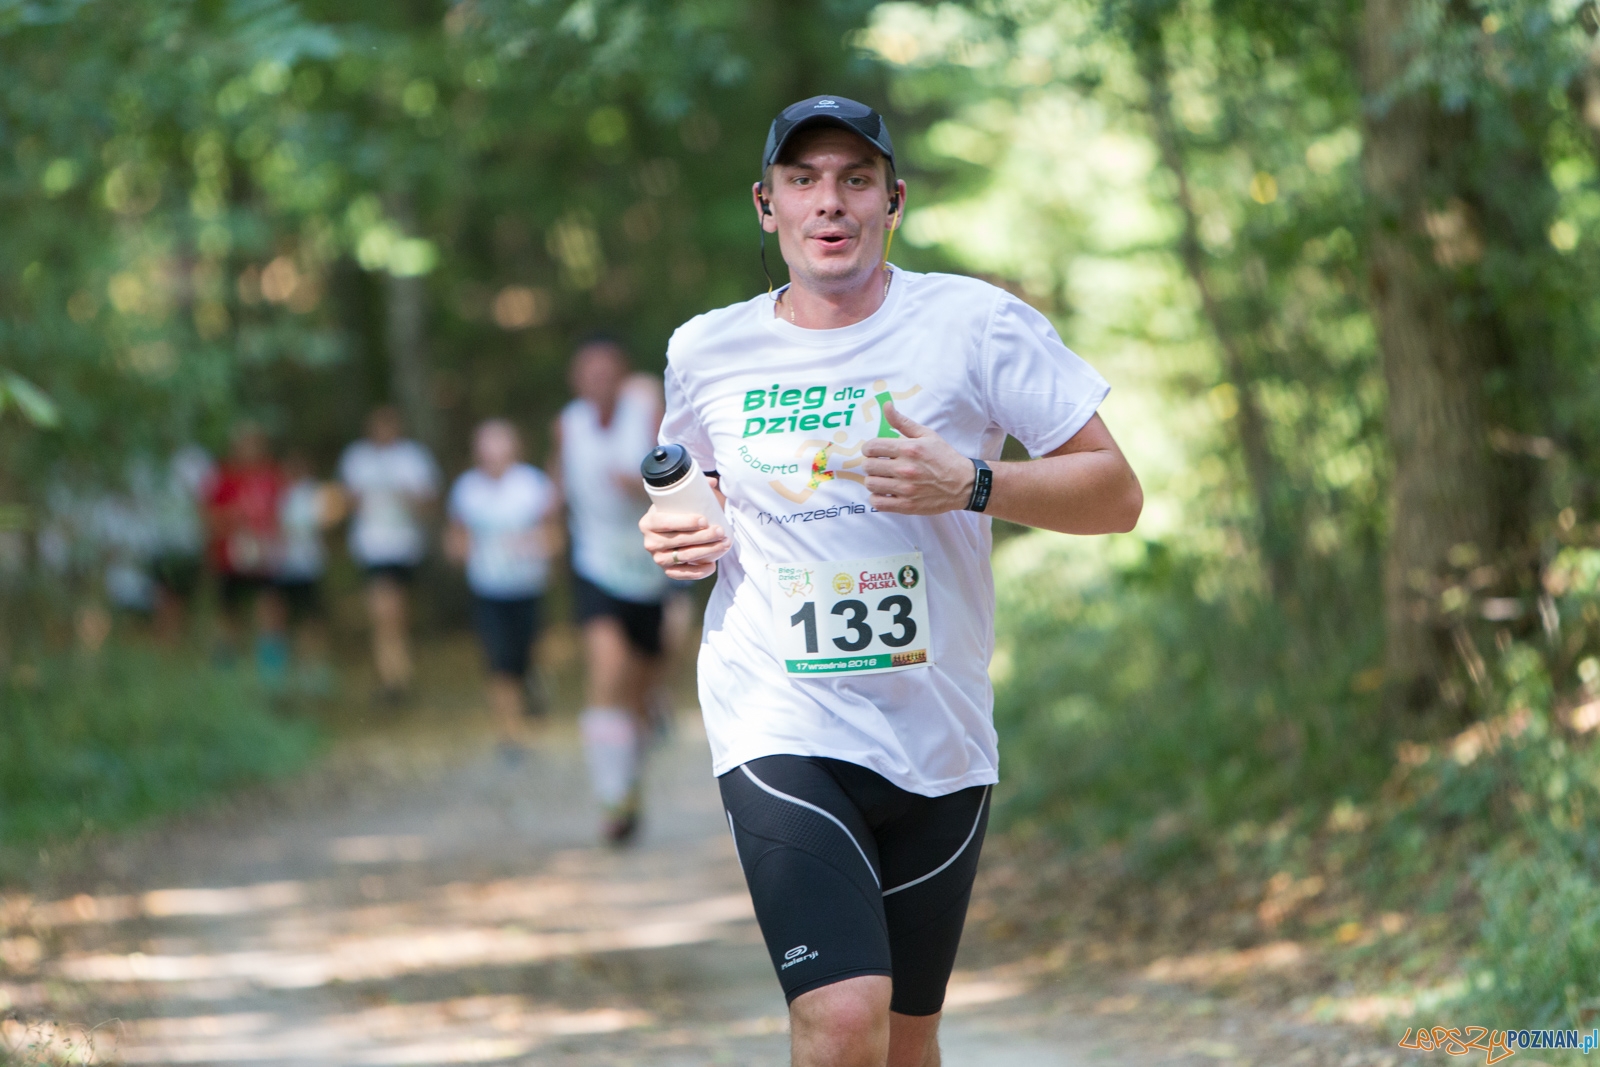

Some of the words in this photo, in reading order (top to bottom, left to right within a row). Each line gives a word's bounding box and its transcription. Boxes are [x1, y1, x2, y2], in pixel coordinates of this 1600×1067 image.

[743, 384, 827, 413] Bieg
[833, 386, 866, 402] dla
[742, 403, 856, 439] Dzieci
[737, 445, 799, 475] Roberta
[775, 501, 866, 525] września
[858, 580, 898, 594] POLSKA
[790, 594, 918, 654] 133
[795, 662, 808, 671] 17
